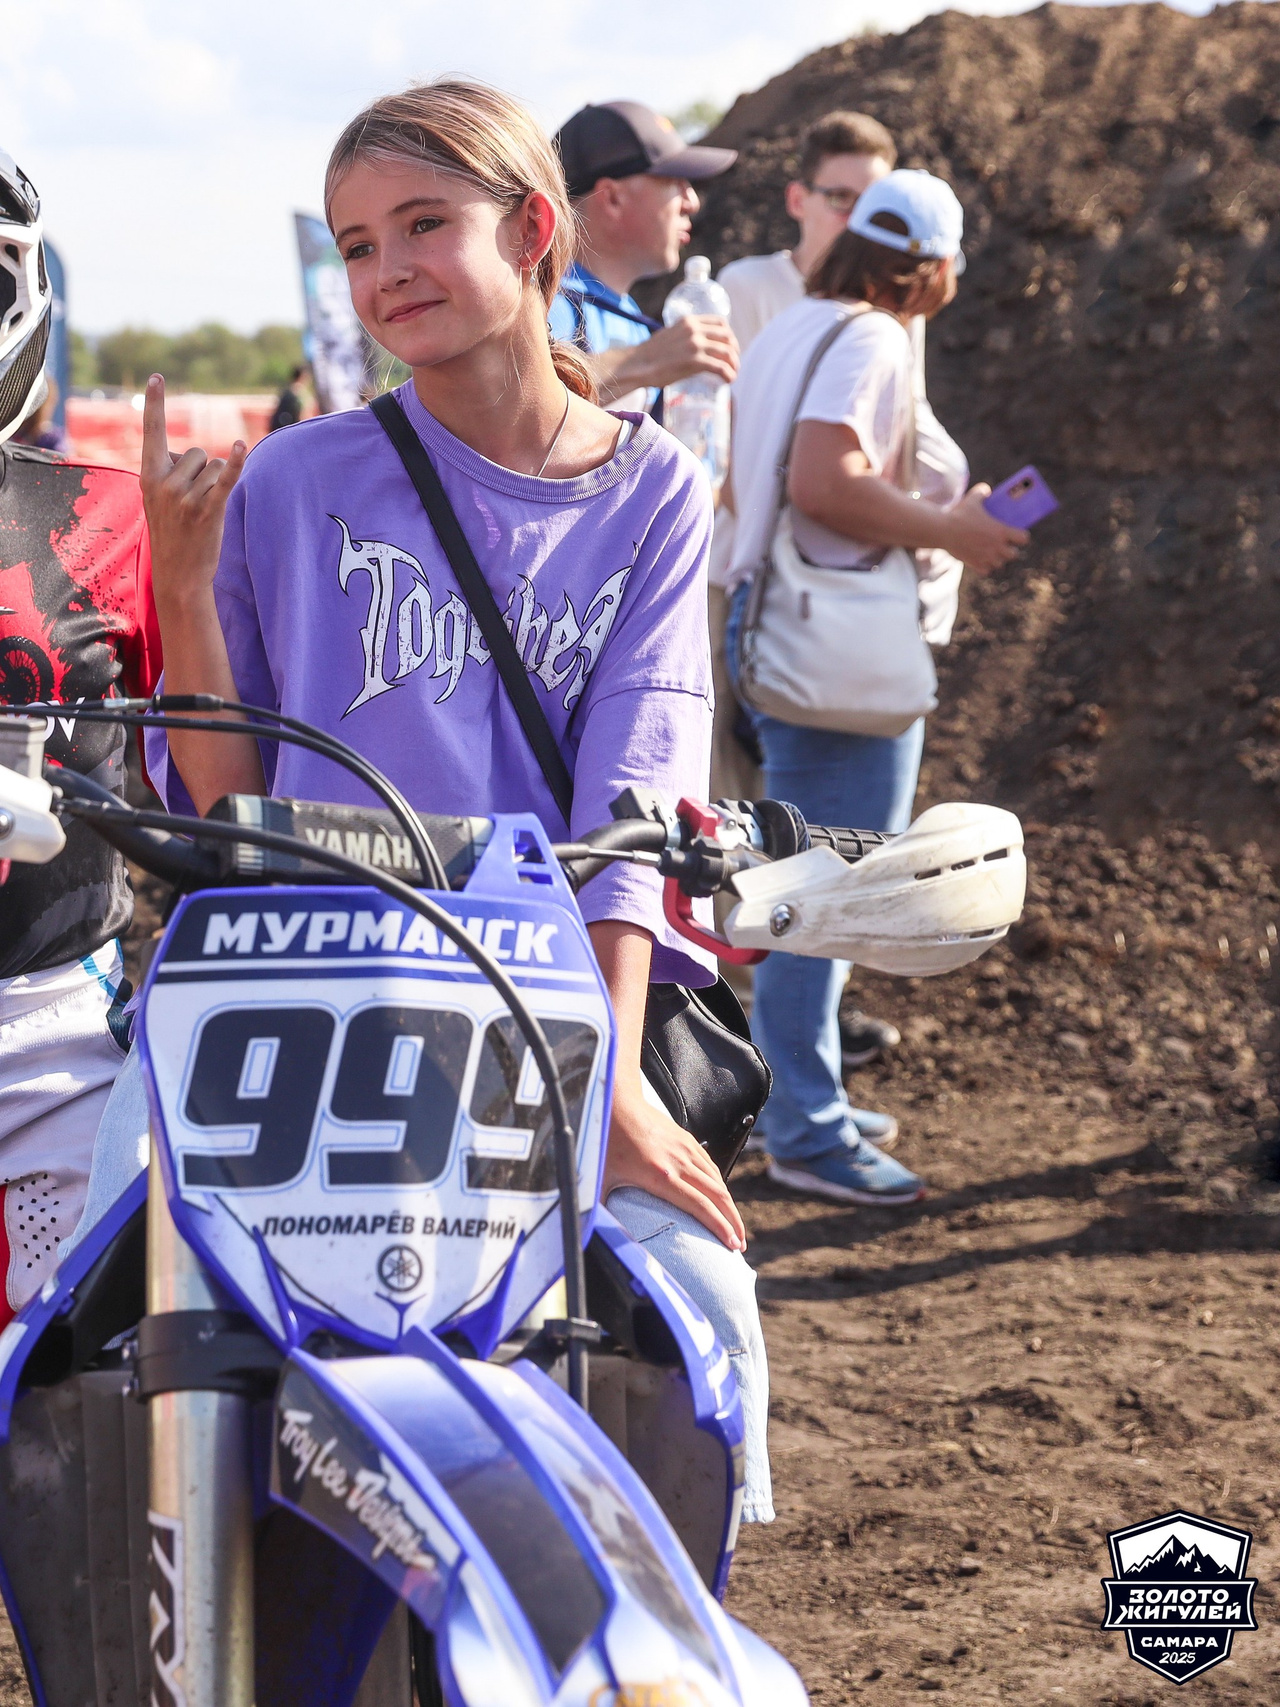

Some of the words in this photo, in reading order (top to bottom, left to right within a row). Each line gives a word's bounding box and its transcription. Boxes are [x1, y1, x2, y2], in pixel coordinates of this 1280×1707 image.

[326, 513, 641, 721] Togher
[305, 827, 422, 871] YAMAH
[202, 910, 558, 963] МУРМАНСК
[183, 1007, 599, 1193] 999
[263, 1210, 415, 1237] ПОНОМАРЁВ
[422, 1215, 517, 1239] ВАЛЕРИЙ
